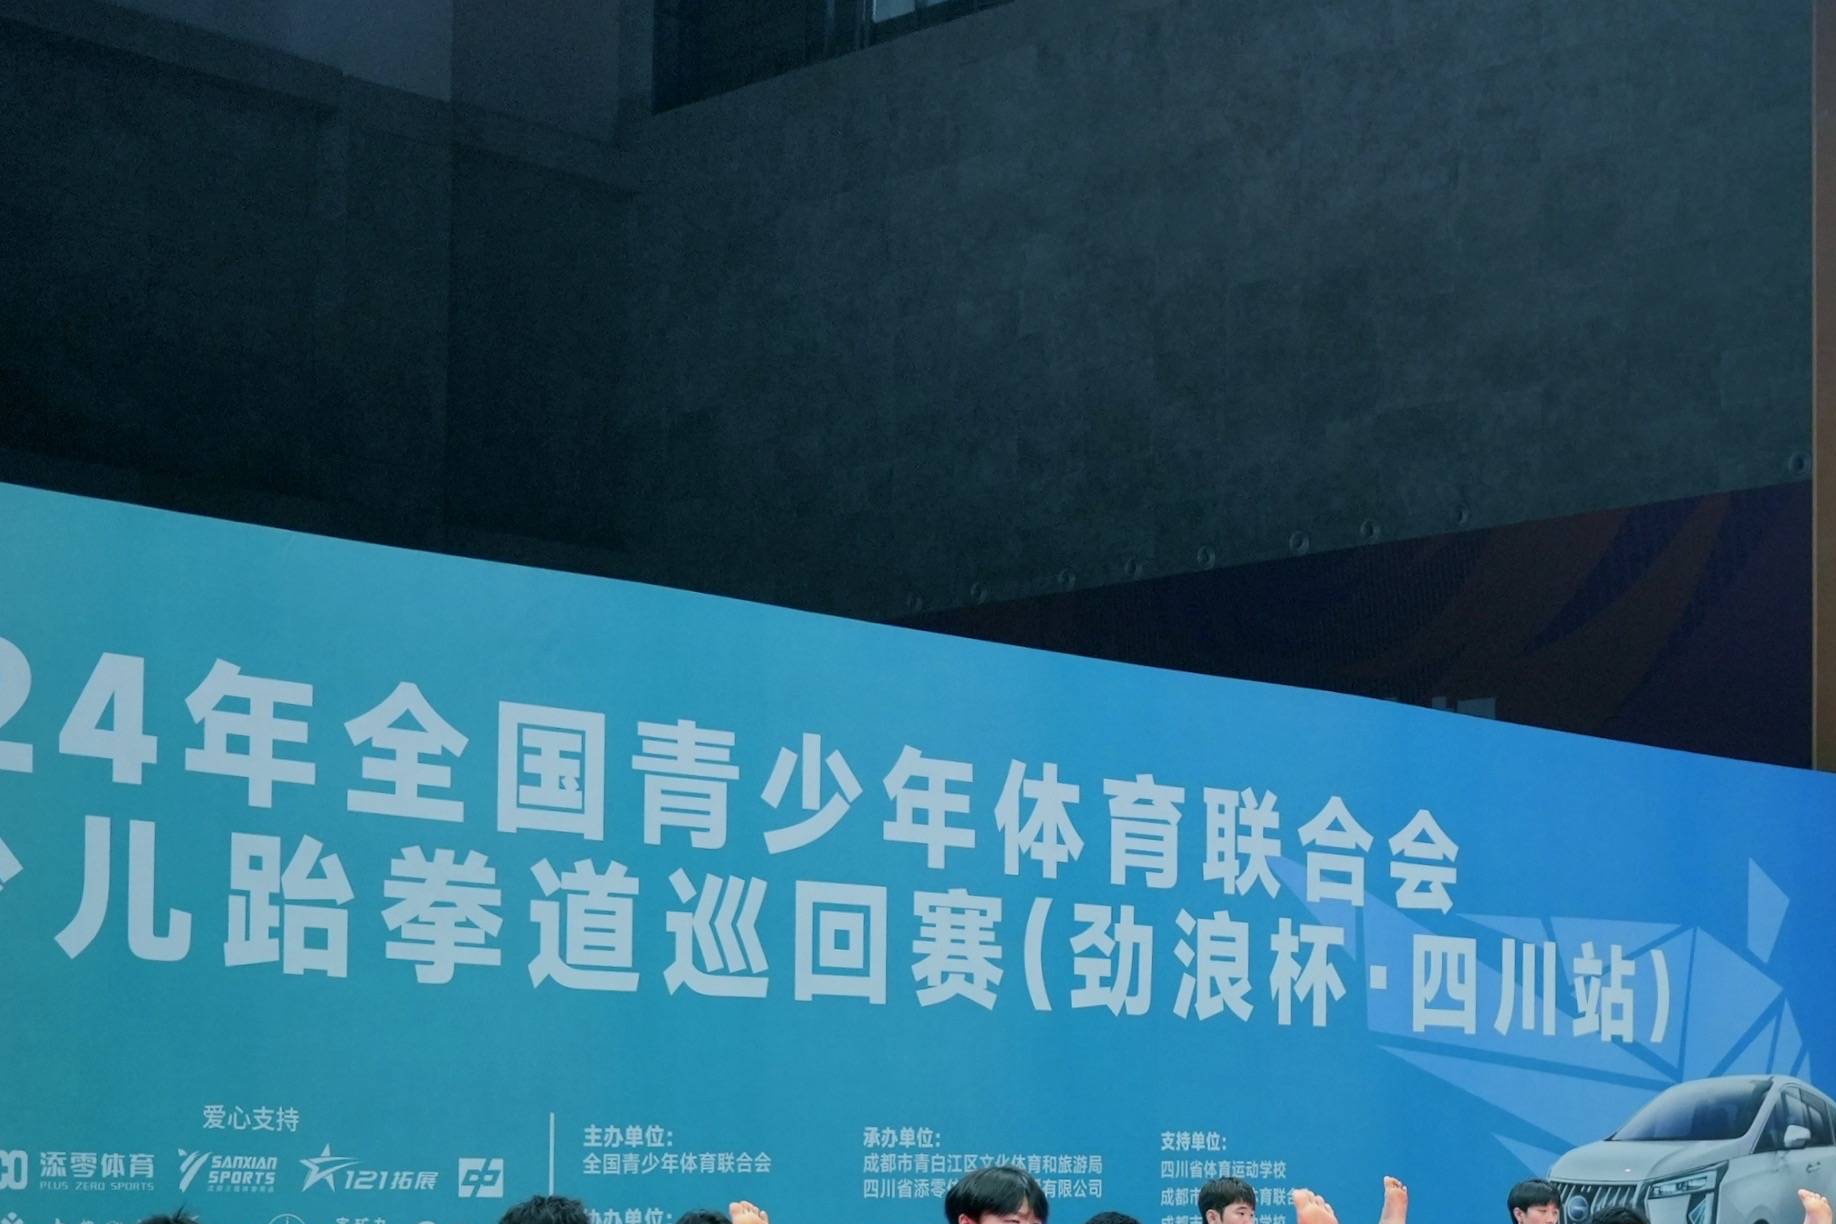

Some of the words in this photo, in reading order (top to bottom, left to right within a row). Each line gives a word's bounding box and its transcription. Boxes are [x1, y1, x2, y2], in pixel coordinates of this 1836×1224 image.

[202, 1104, 300, 1132] 爱心支持
[40, 1151, 155, 1178] 添零体育
[582, 1151, 772, 1175] 全国青少年体育联合会
[1160, 1159, 1287, 1180] 四川省体育运动学校
[40, 1180, 69, 1190] PLUS
[75, 1181, 106, 1191] ZERO
[111, 1181, 155, 1192] SPORTS
[208, 1170, 276, 1185] SPORTS
[343, 1170, 439, 1190] 121拓展
